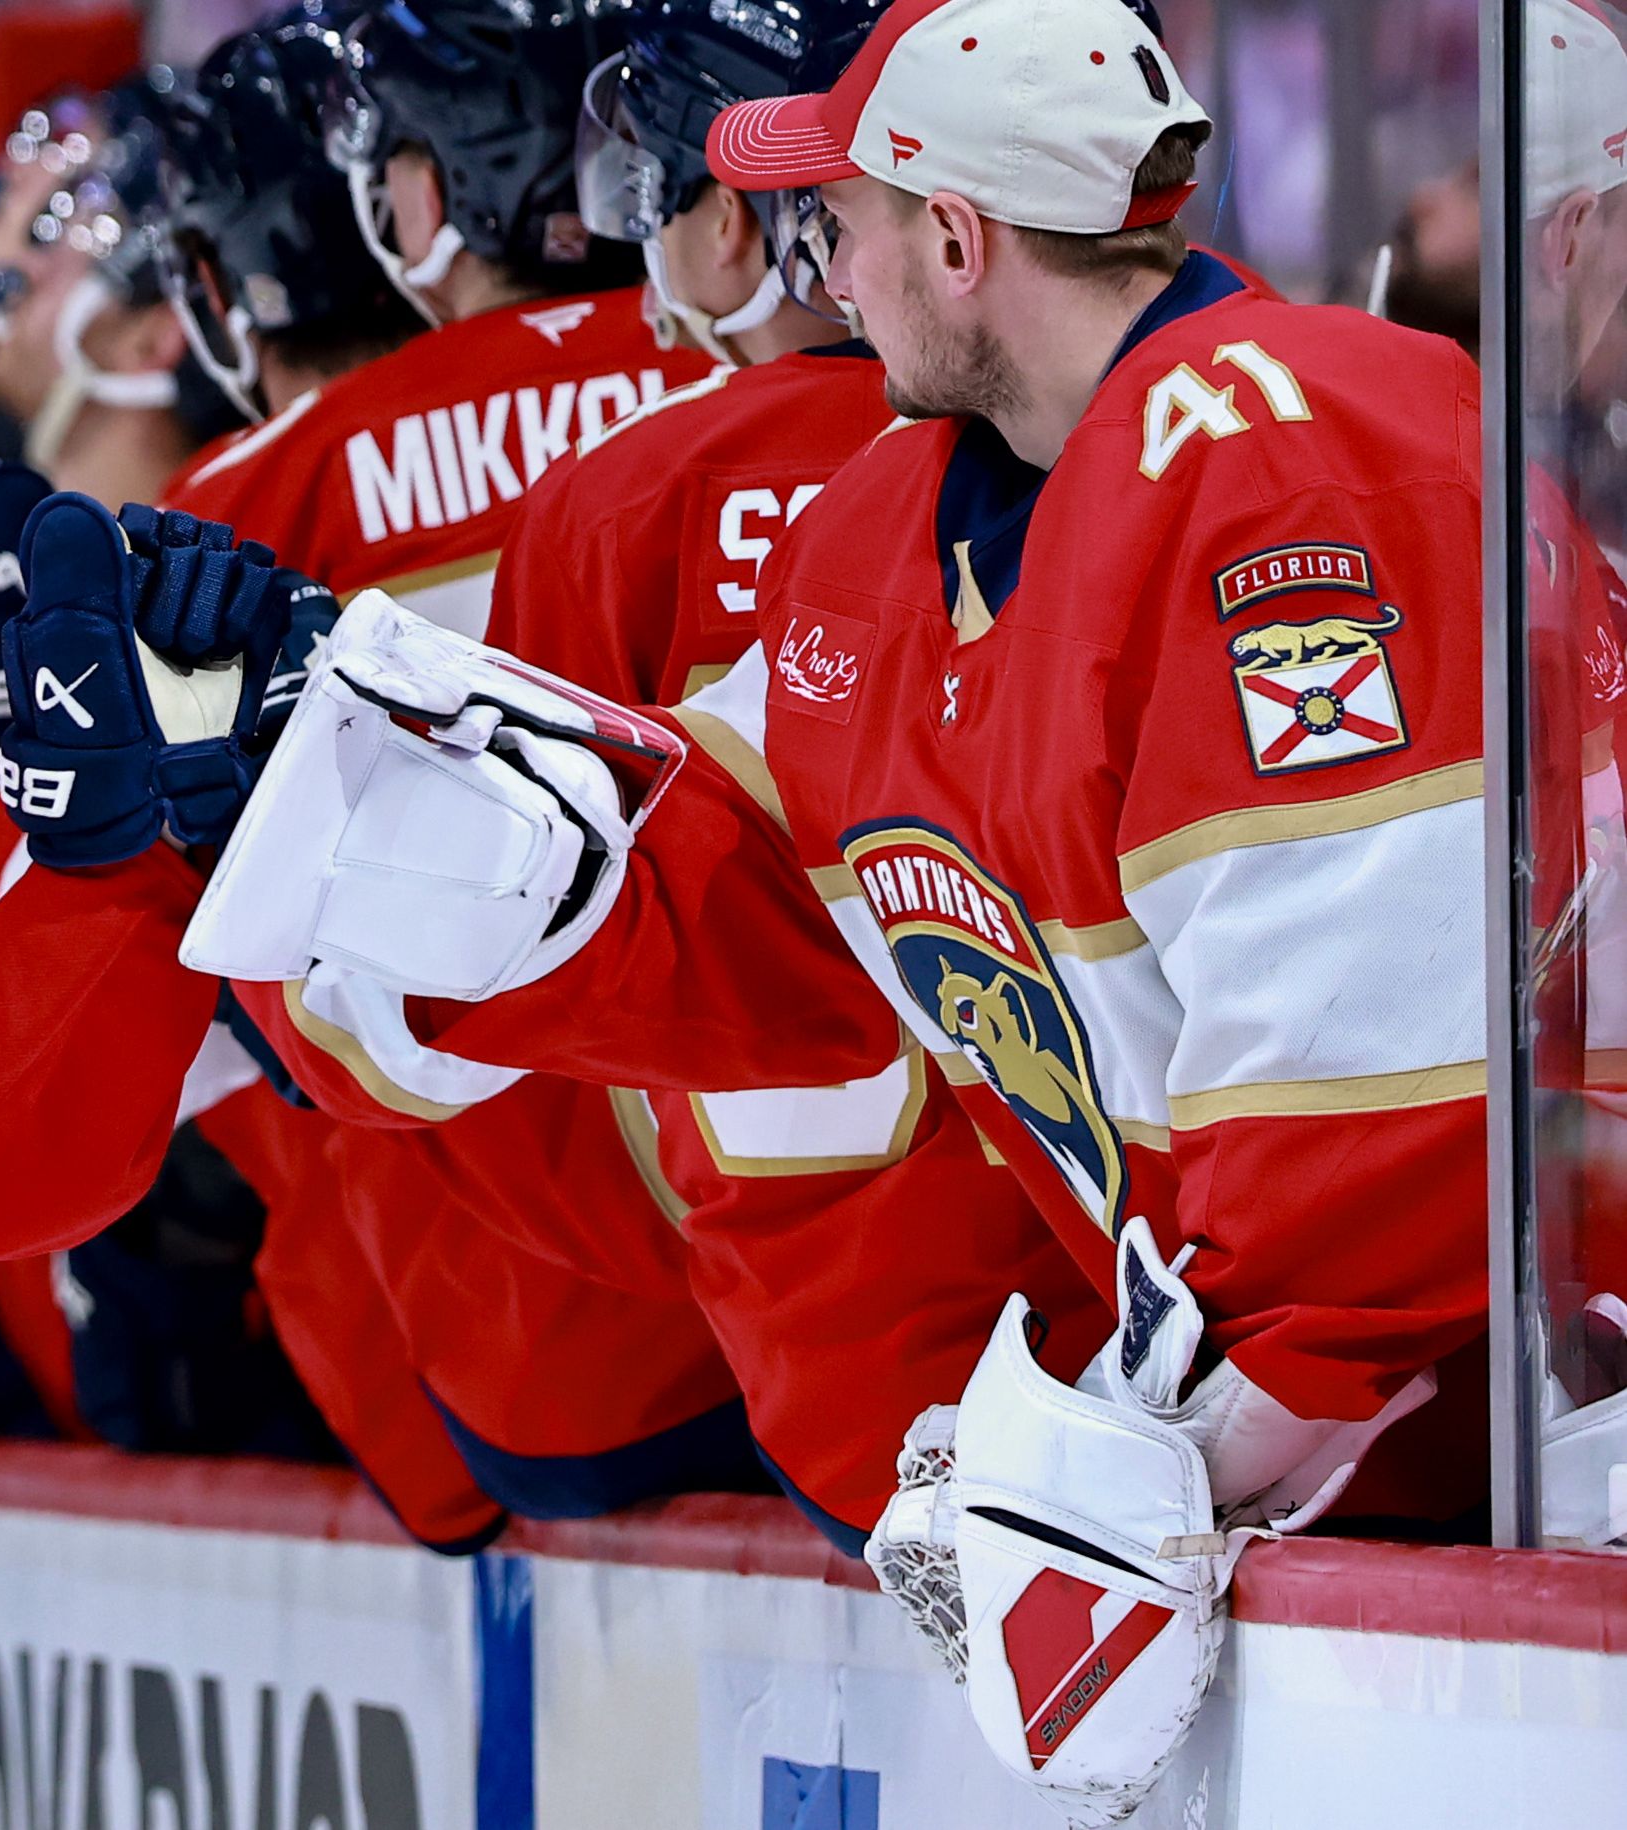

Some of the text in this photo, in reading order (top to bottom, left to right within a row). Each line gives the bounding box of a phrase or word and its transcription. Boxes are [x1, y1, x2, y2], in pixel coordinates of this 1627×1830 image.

[1138, 339, 1312, 481] 41
[716, 483, 825, 613] S
[1235, 556, 1351, 596] FLORIDA
[862, 855, 1016, 953] PANTHERS
[1041, 1657, 1110, 1745] SHADOW
